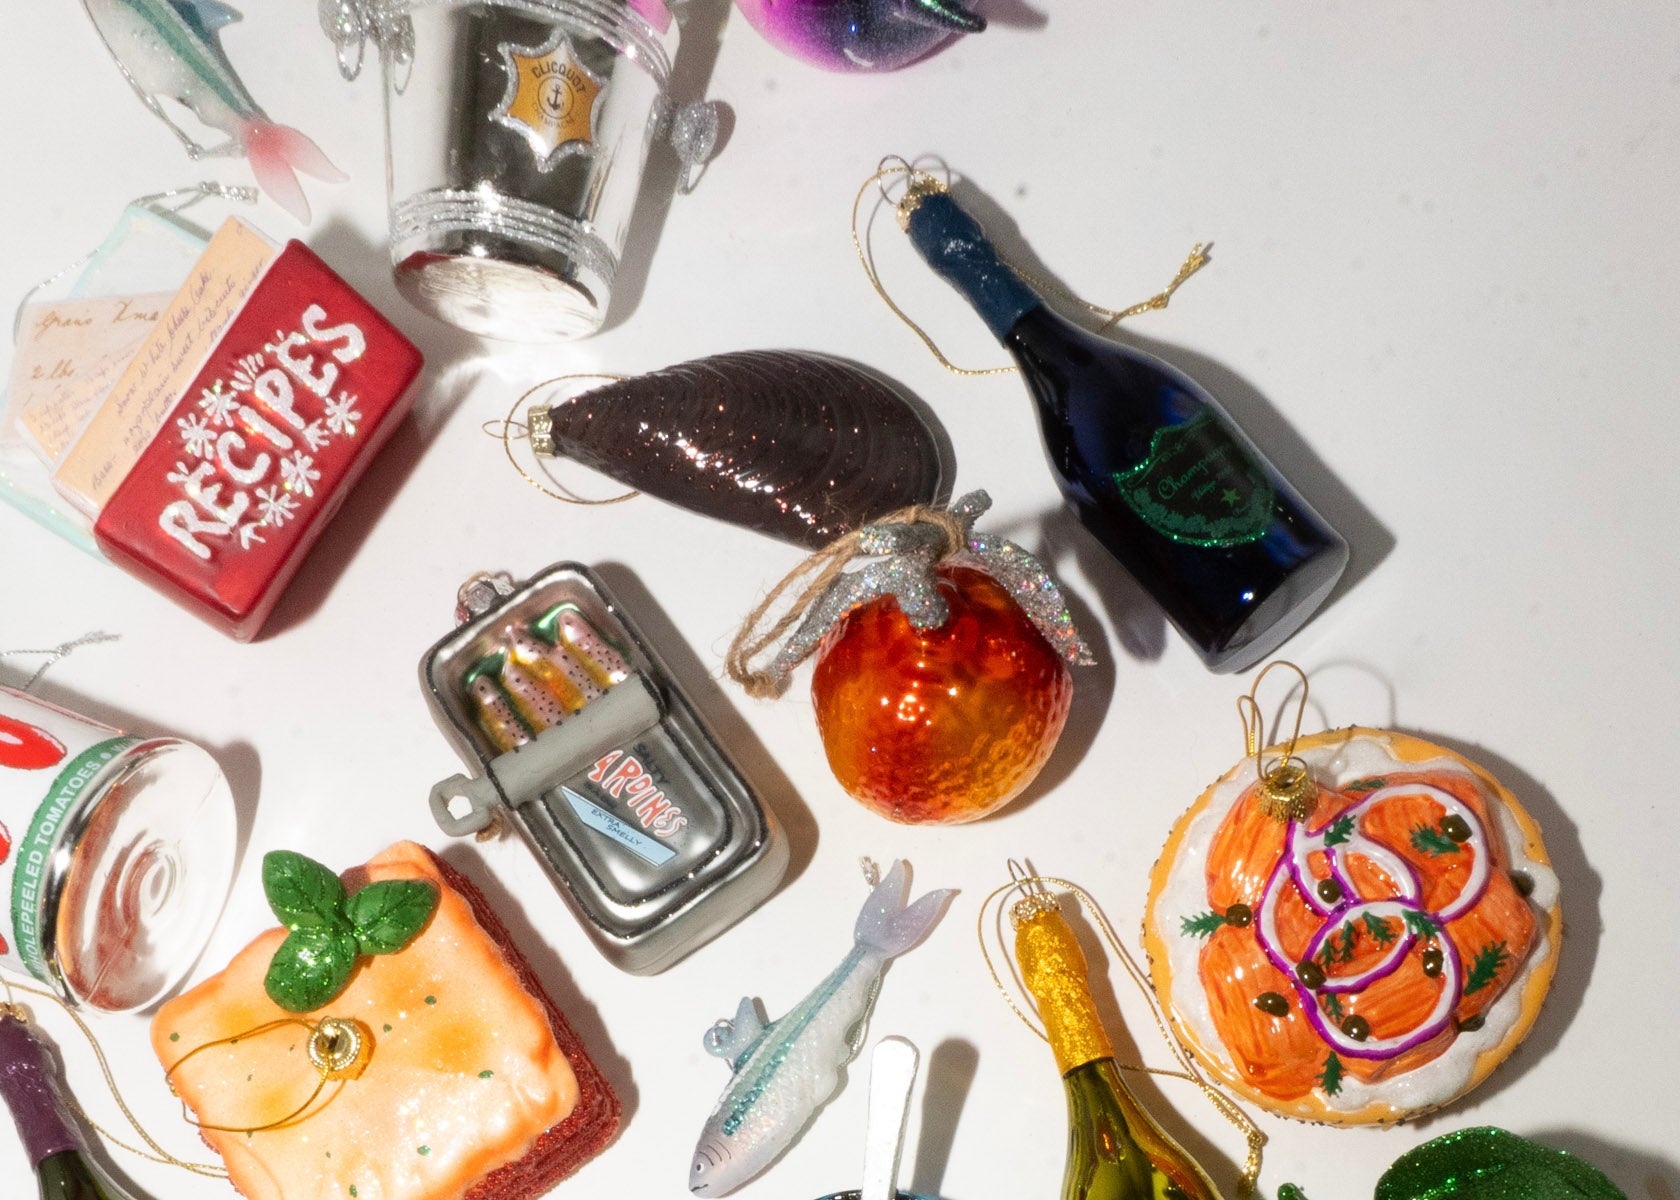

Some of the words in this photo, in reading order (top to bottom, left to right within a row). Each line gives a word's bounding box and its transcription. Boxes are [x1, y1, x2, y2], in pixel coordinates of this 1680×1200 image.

[531, 61, 586, 94] CLICQUOT
[158, 303, 367, 560] RECIPES
[34, 761, 100, 851] TOMATOES
[590, 808, 621, 829] EXTRA
[606, 824, 643, 847] SMELLY
